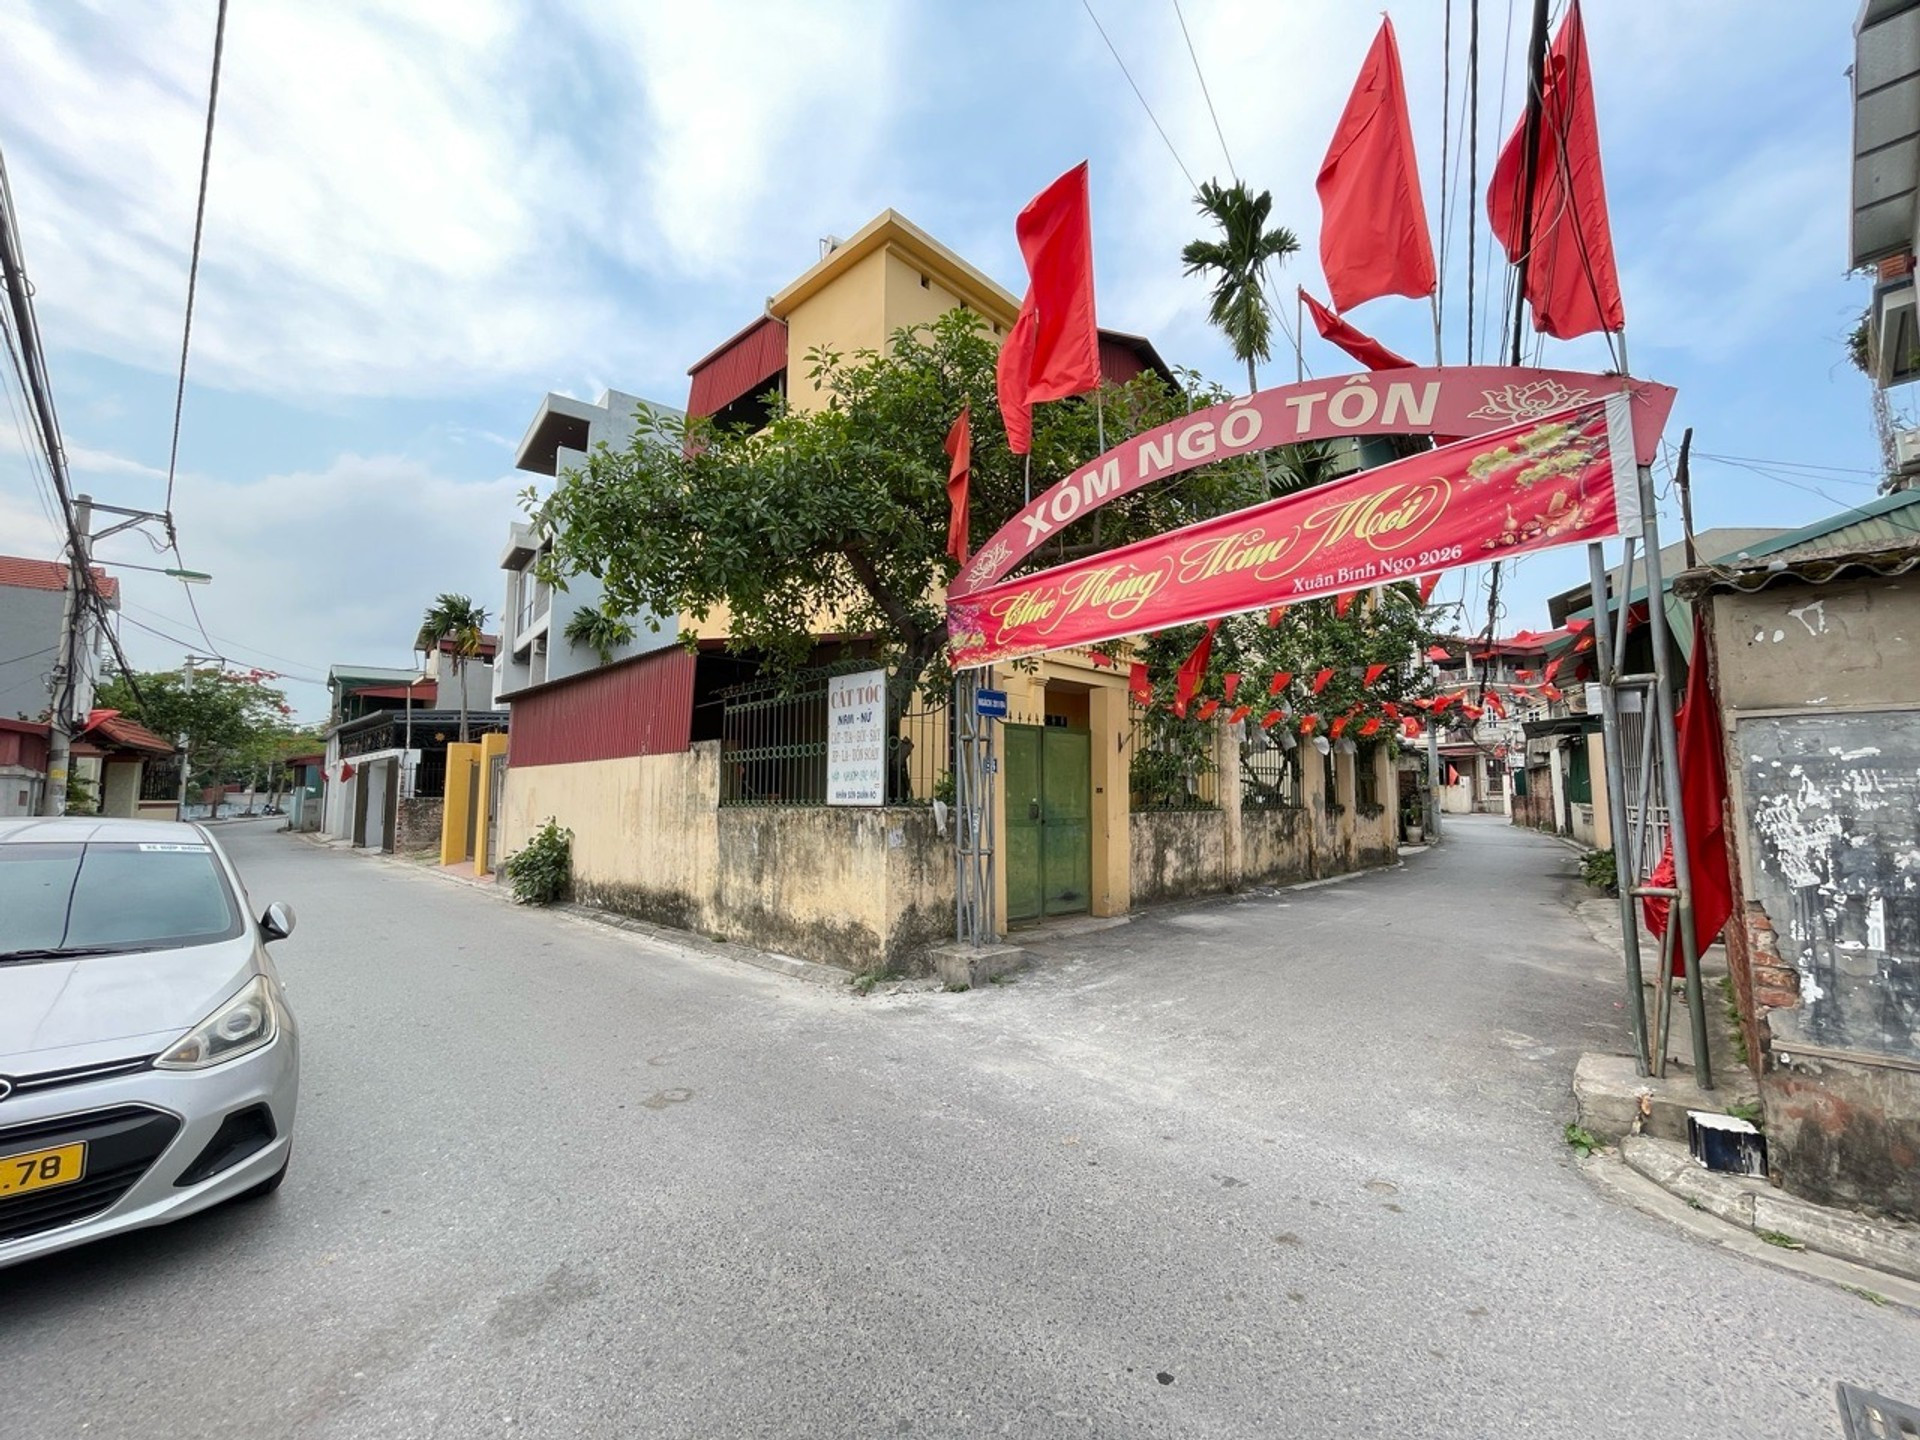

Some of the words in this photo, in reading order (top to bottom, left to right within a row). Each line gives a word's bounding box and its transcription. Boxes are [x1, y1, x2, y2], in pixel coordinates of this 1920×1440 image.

[1022, 458, 1120, 546] XÓM
[1138, 394, 1262, 478] NGÕ
[1286, 374, 1441, 433] TÔN
[990, 586, 1062, 645] Chúc
[1037, 555, 1174, 635] Mừng
[1178, 526, 1300, 584] Năm
[1255, 476, 1451, 580] Mới
[1292, 573, 1335, 594] Xuân
[1380, 557, 1415, 575] Ngọ
[1419, 545, 1462, 566] 2026
[831, 680, 854, 709] CẮT
[857, 680, 881, 705] TÓC
[837, 713, 854, 725] NAM
